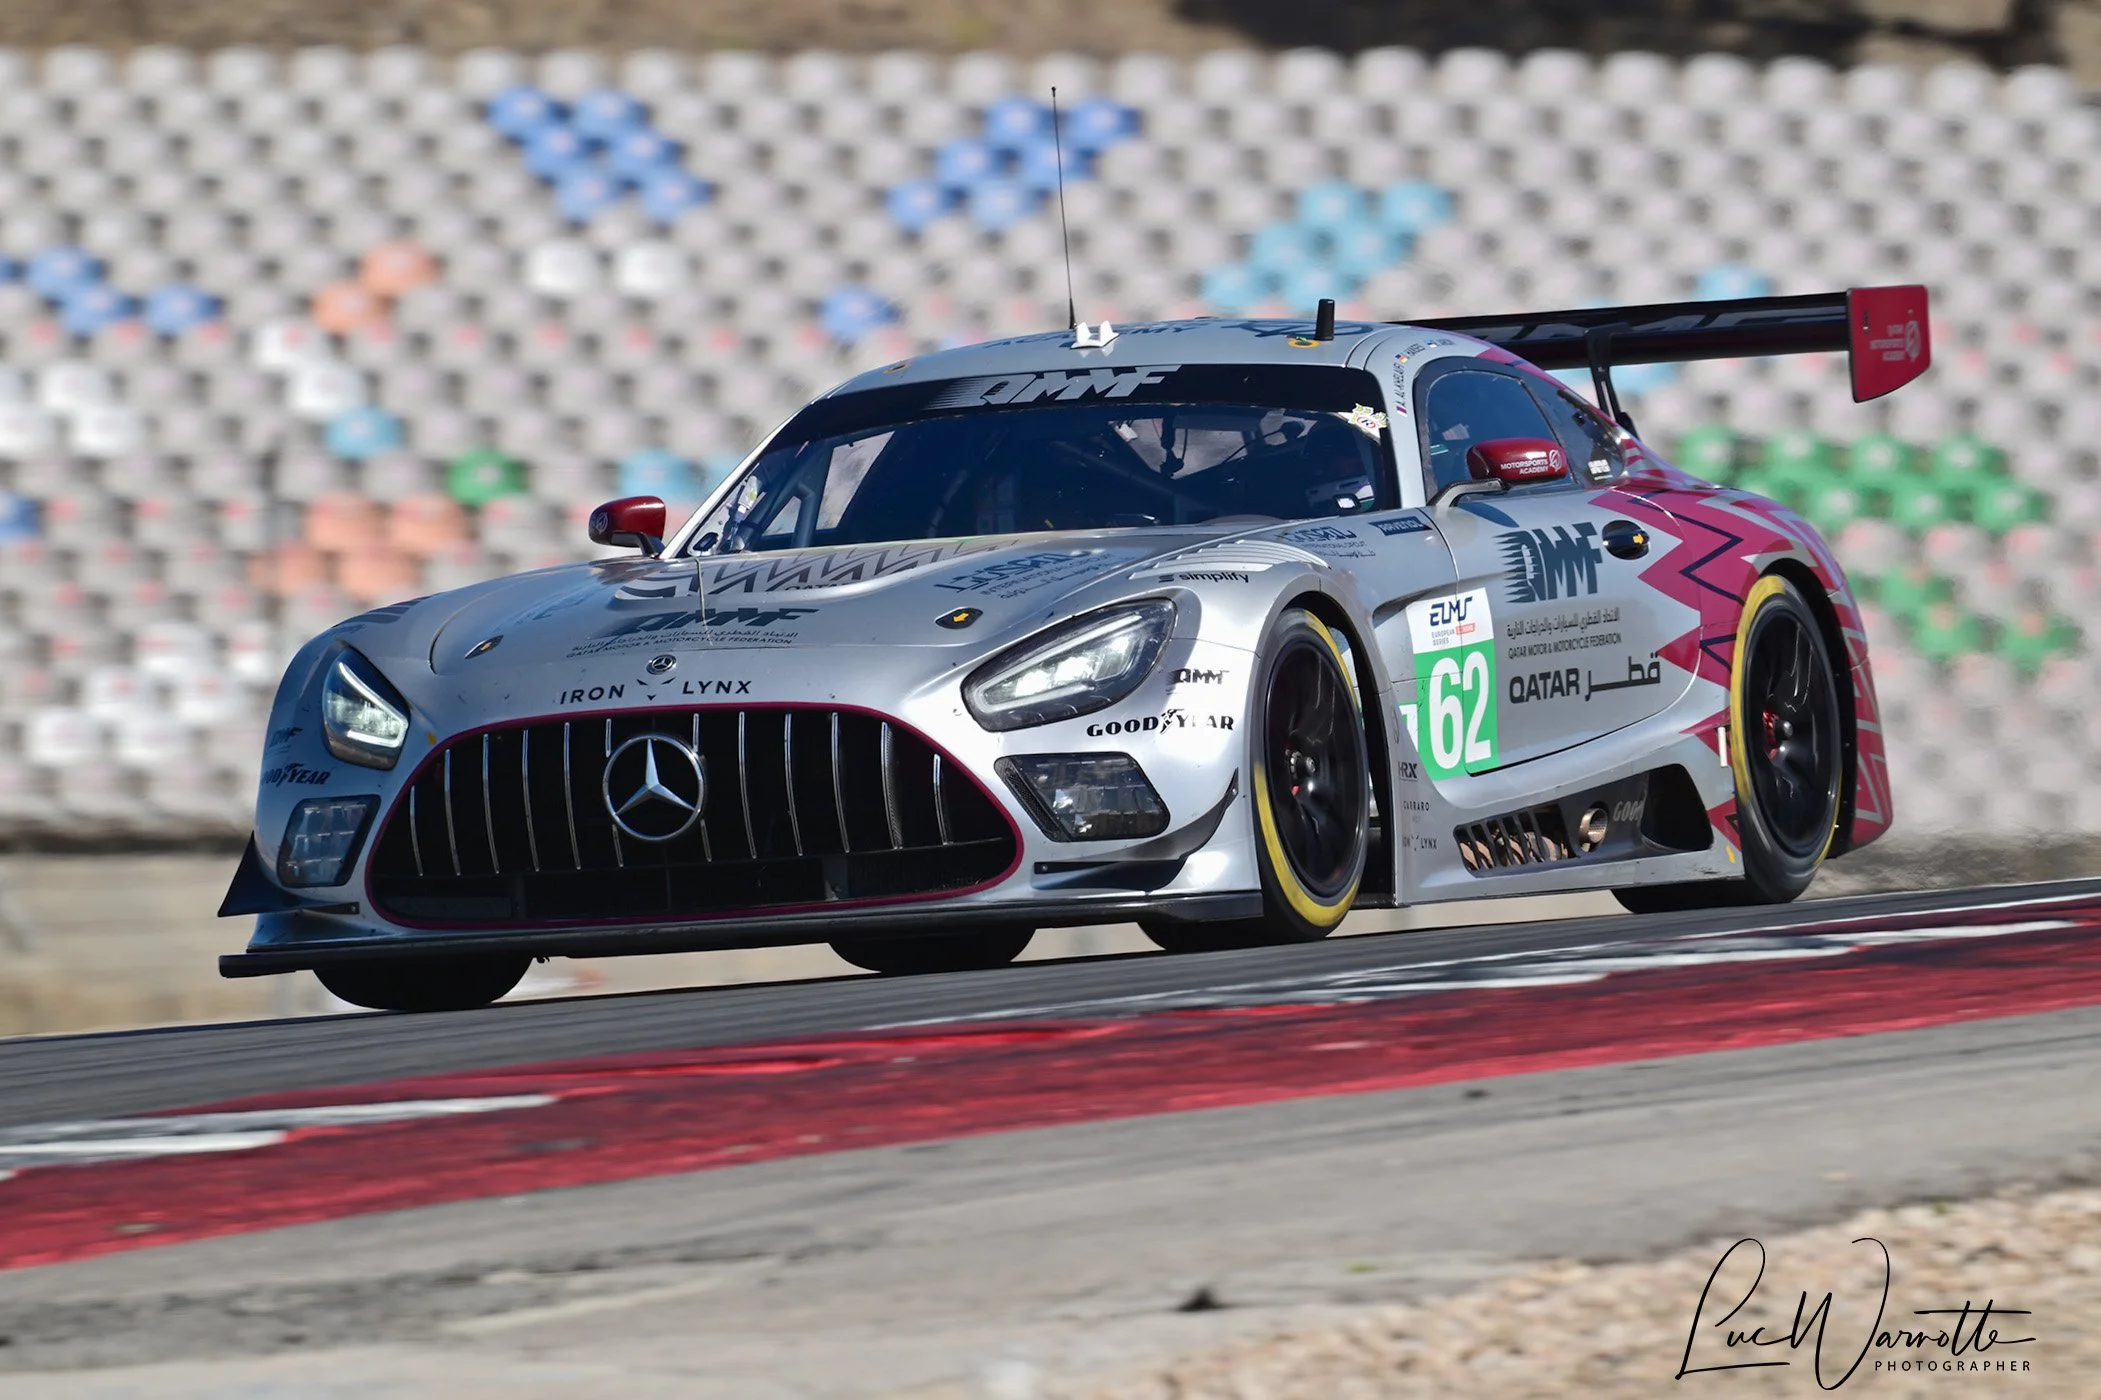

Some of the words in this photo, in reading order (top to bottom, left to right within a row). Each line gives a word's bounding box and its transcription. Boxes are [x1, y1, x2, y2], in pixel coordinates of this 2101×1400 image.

[930, 364, 1182, 411] QMMF
[1500, 459, 1549, 471] MOTORSPORTS
[1509, 466, 1549, 475] ACADEMY
[1179, 571, 1249, 584] simplify
[1429, 596, 1473, 626] ELMS
[728, 635, 793, 645] FEDERATION
[1431, 627, 1455, 640] EUROPEAN
[1507, 645, 1527, 660] QATAR
[1528, 642, 1547, 656] MOTOR
[1509, 667, 1580, 704] QATAR
[1585, 652, 1661, 702] قطر
[560, 684, 625, 705] IRON
[683, 680, 752, 695] LYNX
[1428, 650, 1492, 770] 62
[1420, 838, 1438, 850] LYNX
